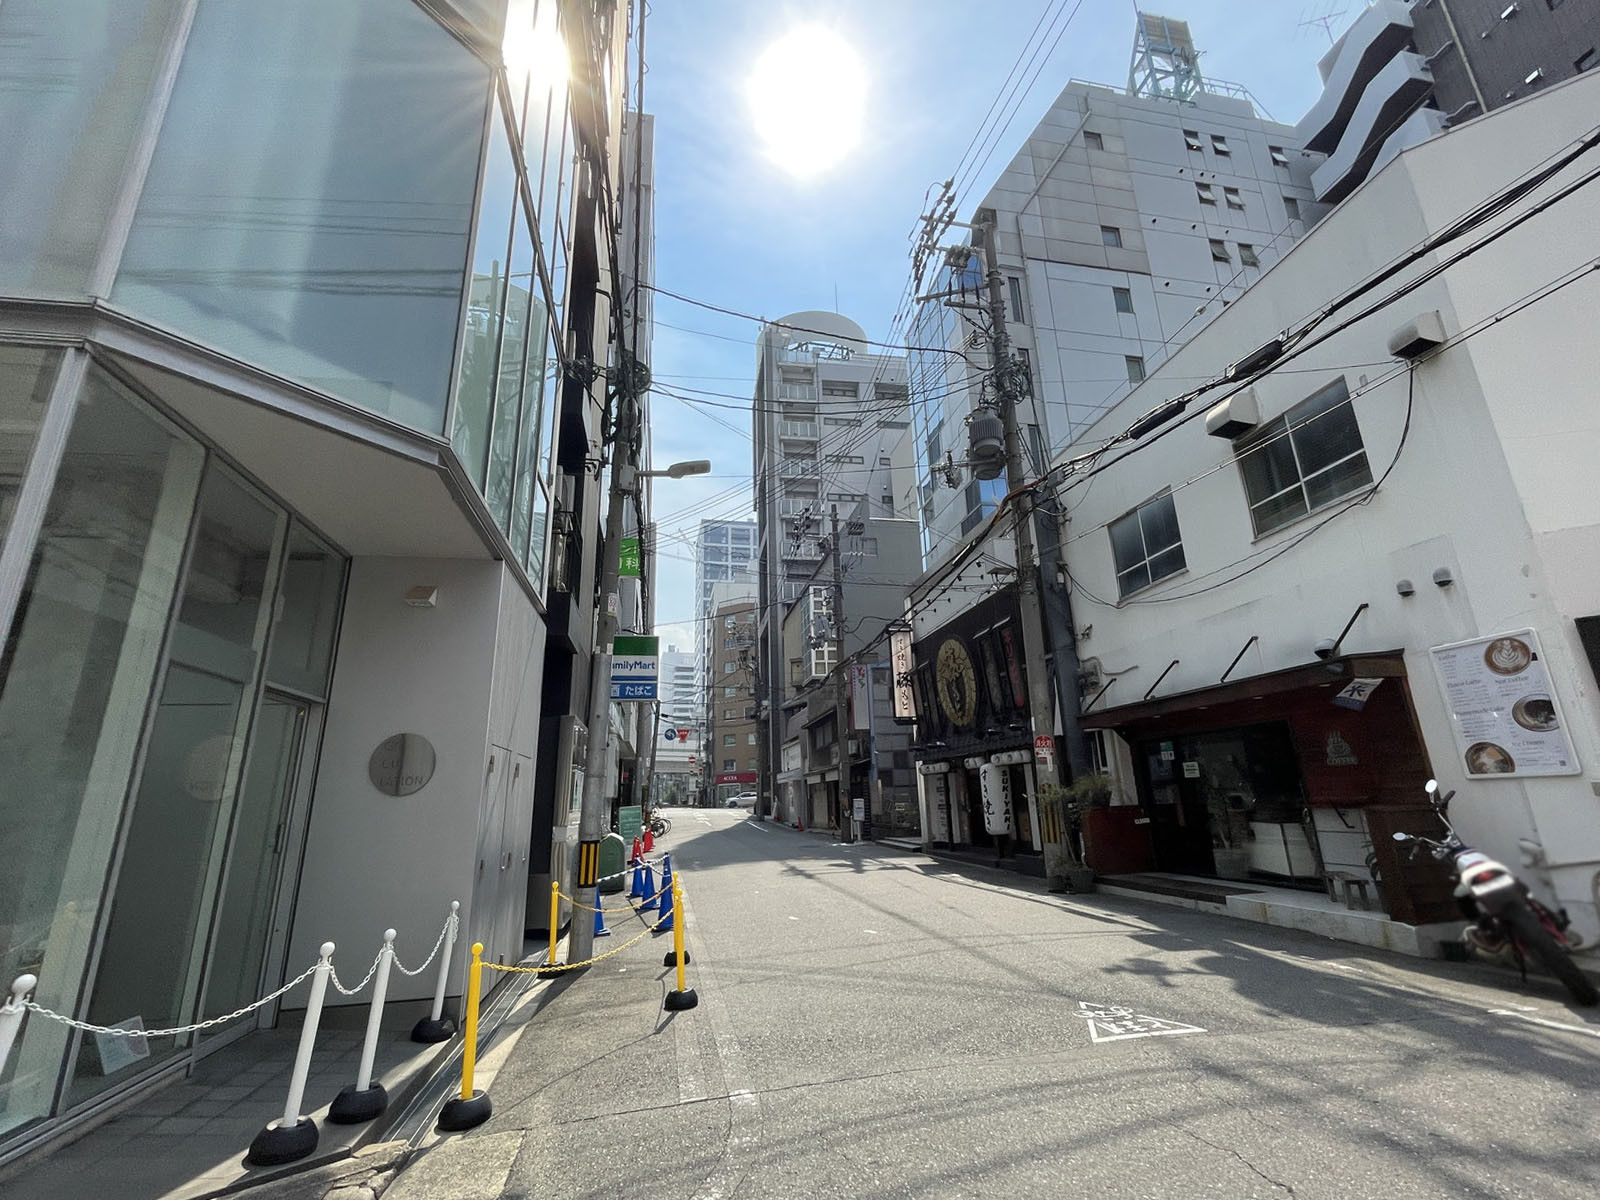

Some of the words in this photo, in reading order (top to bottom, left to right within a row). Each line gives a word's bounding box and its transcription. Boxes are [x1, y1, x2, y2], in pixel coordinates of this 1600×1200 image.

[619, 557, 640, 570] 科
[625, 685, 652, 696] たばこ
[1001, 769, 1011, 831] SUKIYAKI
